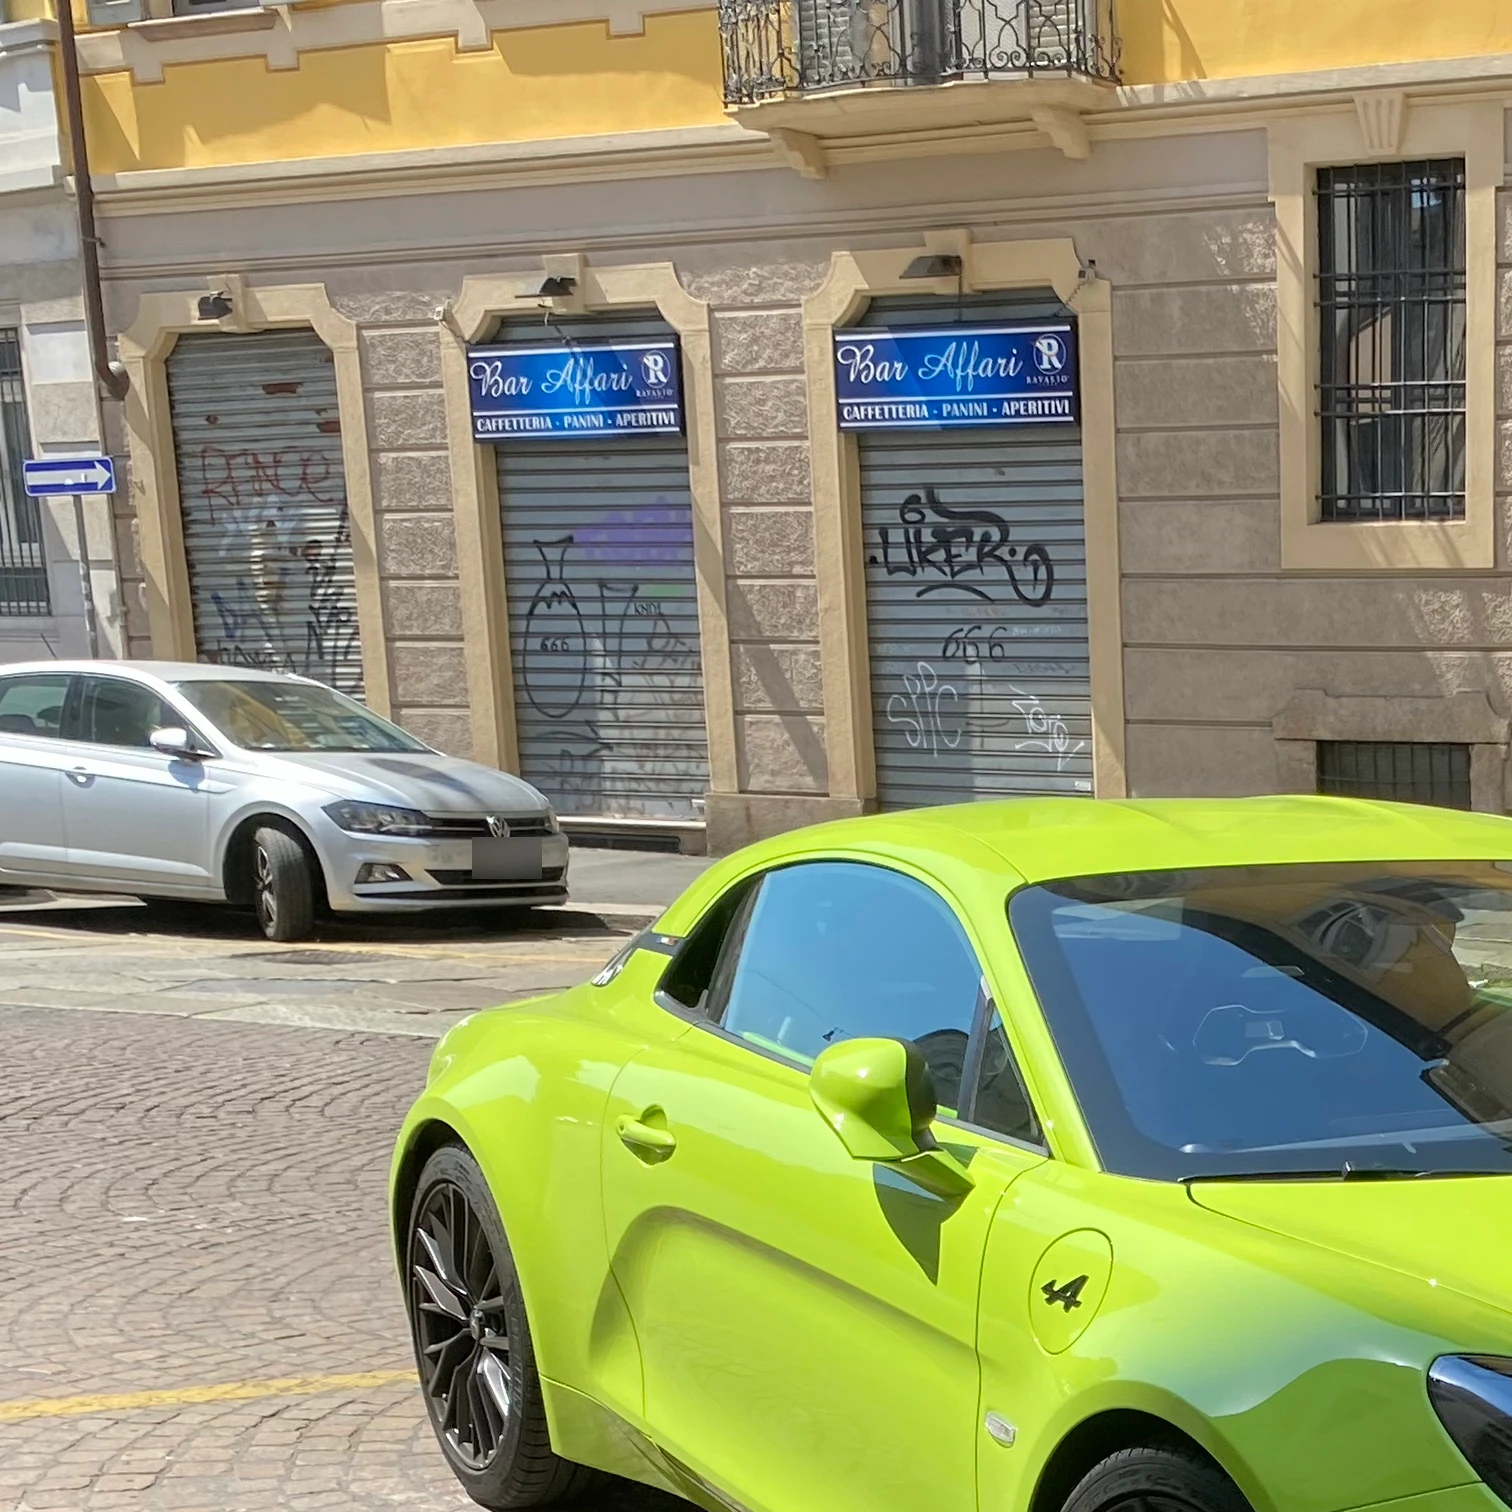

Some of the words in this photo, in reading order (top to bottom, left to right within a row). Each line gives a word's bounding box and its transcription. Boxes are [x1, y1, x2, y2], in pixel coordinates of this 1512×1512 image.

[470, 360, 533, 397] Bar
[541, 357, 633, 405] Affari
[837, 344, 909, 384] Bar
[918, 340, 1023, 392] Affari
[477, 415, 551, 431] CAFFETTERIA
[564, 413, 604, 429] PANINI
[615, 410, 675, 427] APERITIVI
[843, 404, 929, 420] CAFFETTERIA
[942, 402, 988, 417] PANINI
[1002, 399, 1070, 416] APERITIVI
[540, 636, 570, 652] 666
[942, 624, 1008, 664] 666
